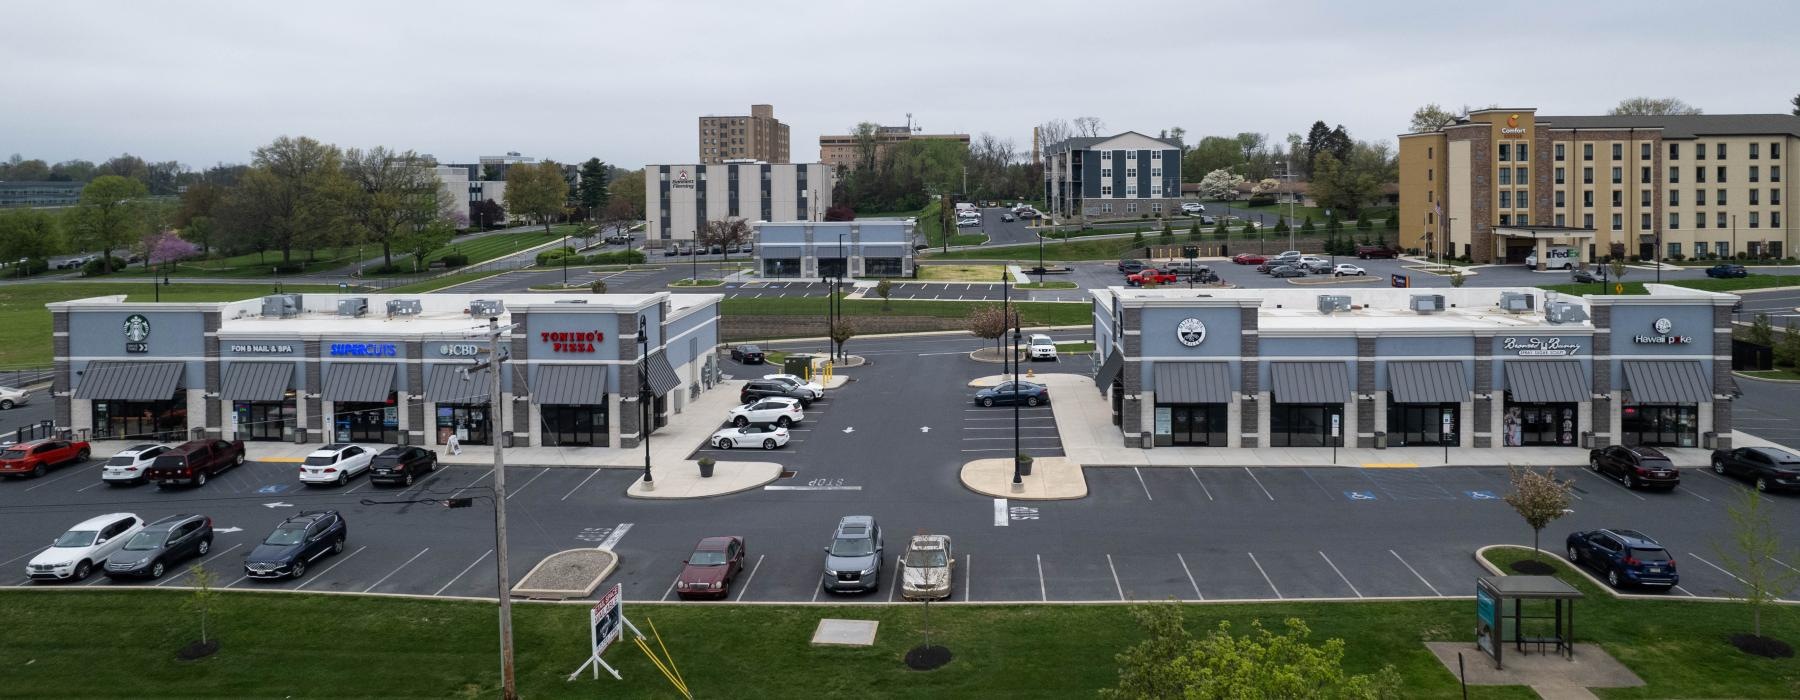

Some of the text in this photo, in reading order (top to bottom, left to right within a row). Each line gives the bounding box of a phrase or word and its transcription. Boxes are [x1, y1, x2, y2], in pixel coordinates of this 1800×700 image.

[541, 329, 604, 342] TONINO'S
[1635, 335, 1666, 343] Hawaii
[231, 345, 246, 353] FON
[252, 345, 270, 353] NAIL
[270, 345, 277, 353] &
[277, 345, 292, 353] SPA
[331, 344, 396, 356] SUPERCUTS
[453, 344, 478, 356] CBD
[553, 342, 596, 353] PIZZA
[1548, 337, 1581, 356] Bunny
